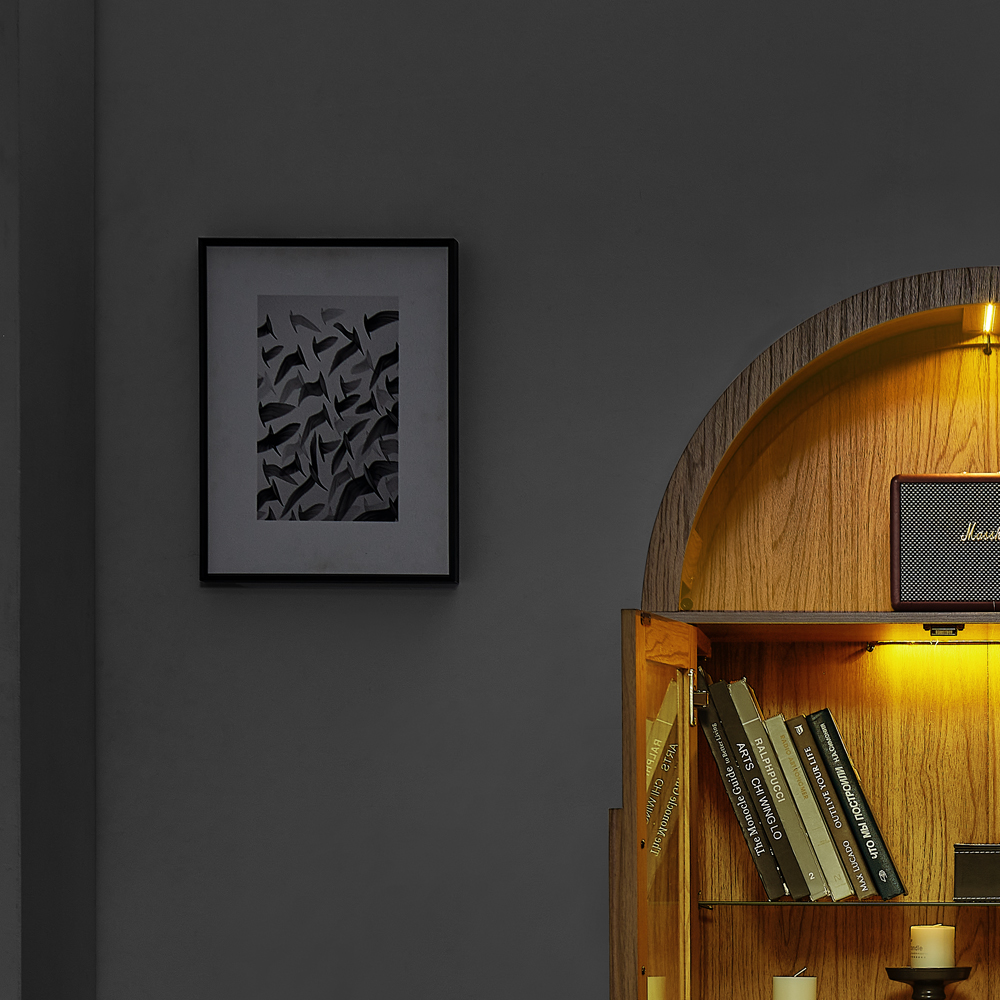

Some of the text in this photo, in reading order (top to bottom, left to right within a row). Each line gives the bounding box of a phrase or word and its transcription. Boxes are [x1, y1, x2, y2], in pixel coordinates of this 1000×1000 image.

[780, 735, 791, 754] RADIO
[804, 747, 816, 765] LIFE
[726, 767, 741, 795] Guide
[755, 738, 785, 802] RALPHPUCCI
[813, 765, 826, 790] YOUR
[737, 744, 782, 840] ARTS CHI WING LO
[835, 767, 864, 820] ПОСТРОИЛИ
[737, 796, 758, 836] Monocle
[822, 791, 842, 828] OUTLIVE
[858, 823, 871, 838] МЫ
[754, 837, 765, 856] The
[866, 840, 878, 859] ЧТО
